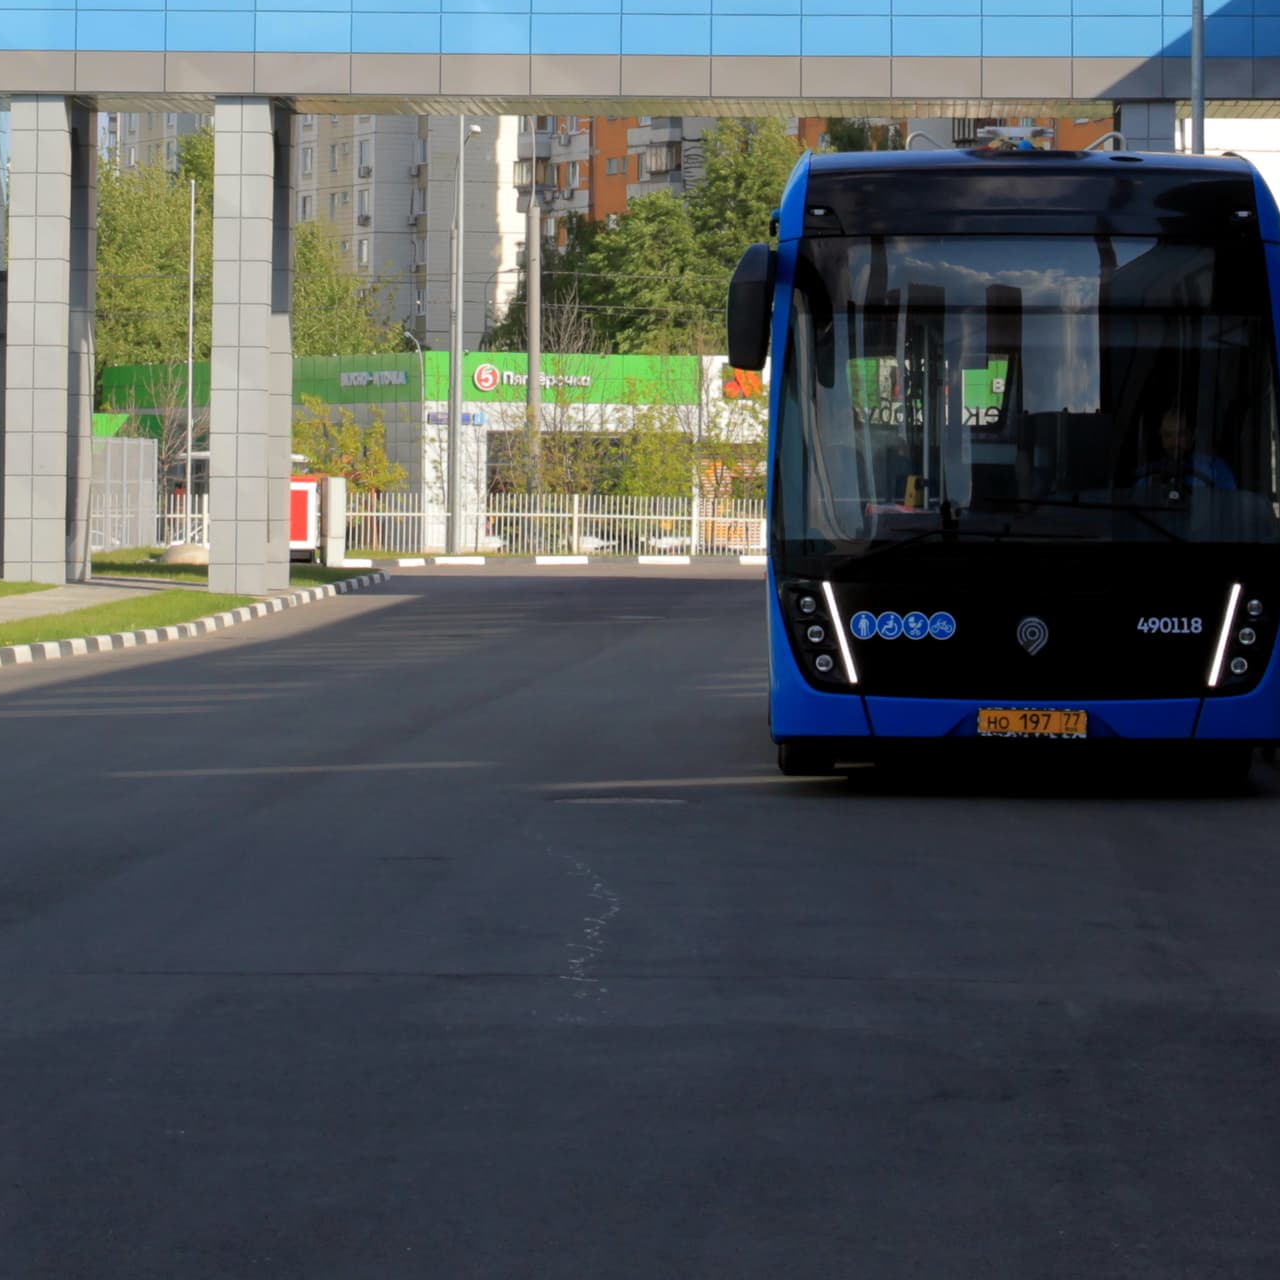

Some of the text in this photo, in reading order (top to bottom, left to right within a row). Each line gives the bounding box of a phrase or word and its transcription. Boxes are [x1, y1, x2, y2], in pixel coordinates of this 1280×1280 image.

[1136, 617, 1203, 634] 490118
[1019, 713, 1052, 731] 197
[1063, 712, 1080, 727] 77
